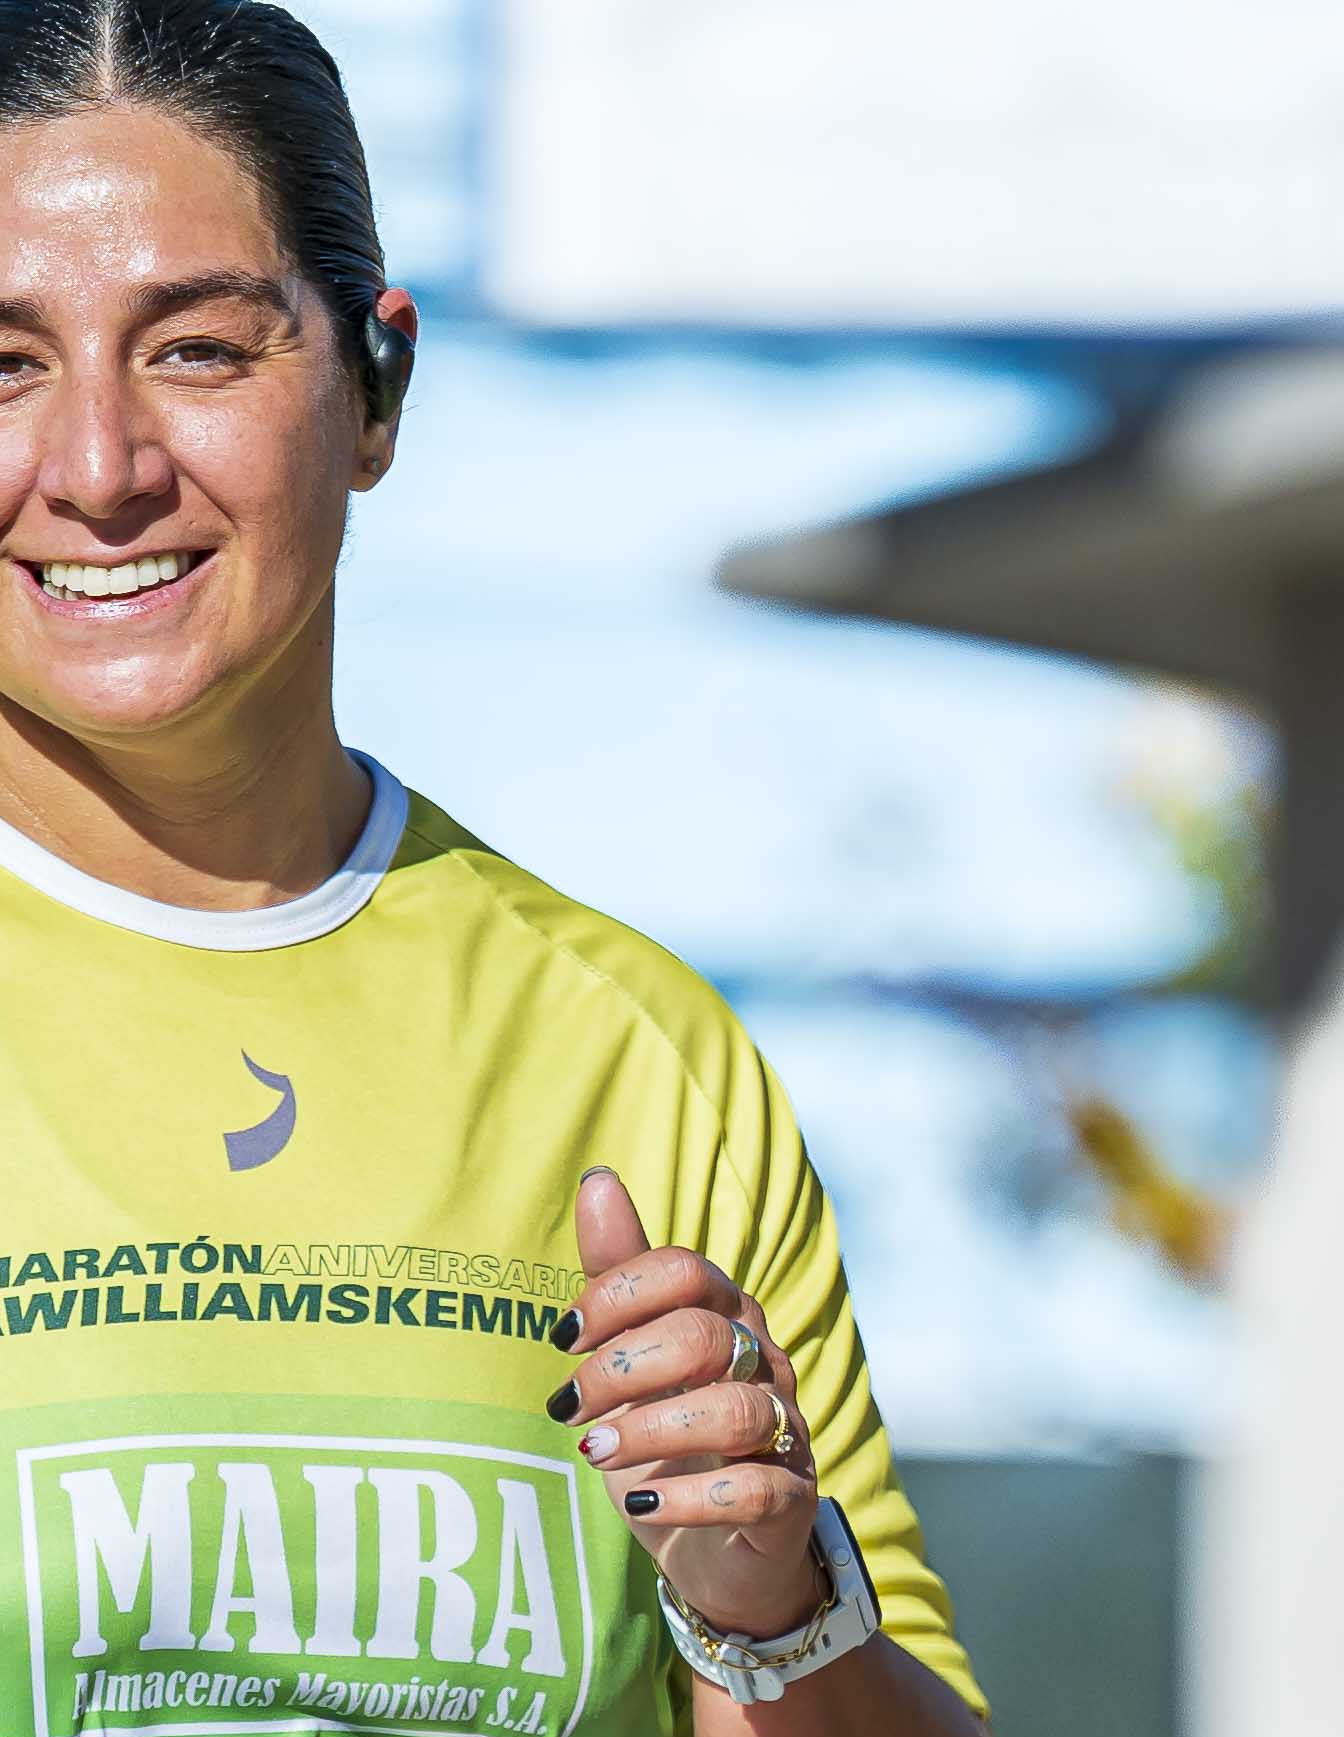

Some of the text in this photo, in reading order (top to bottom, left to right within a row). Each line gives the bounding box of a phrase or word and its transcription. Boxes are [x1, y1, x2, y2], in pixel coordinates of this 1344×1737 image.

[60, 1462, 566, 1677] MAIRA
[72, 1670, 549, 1735] Almacenes Mayoristas S.A.
